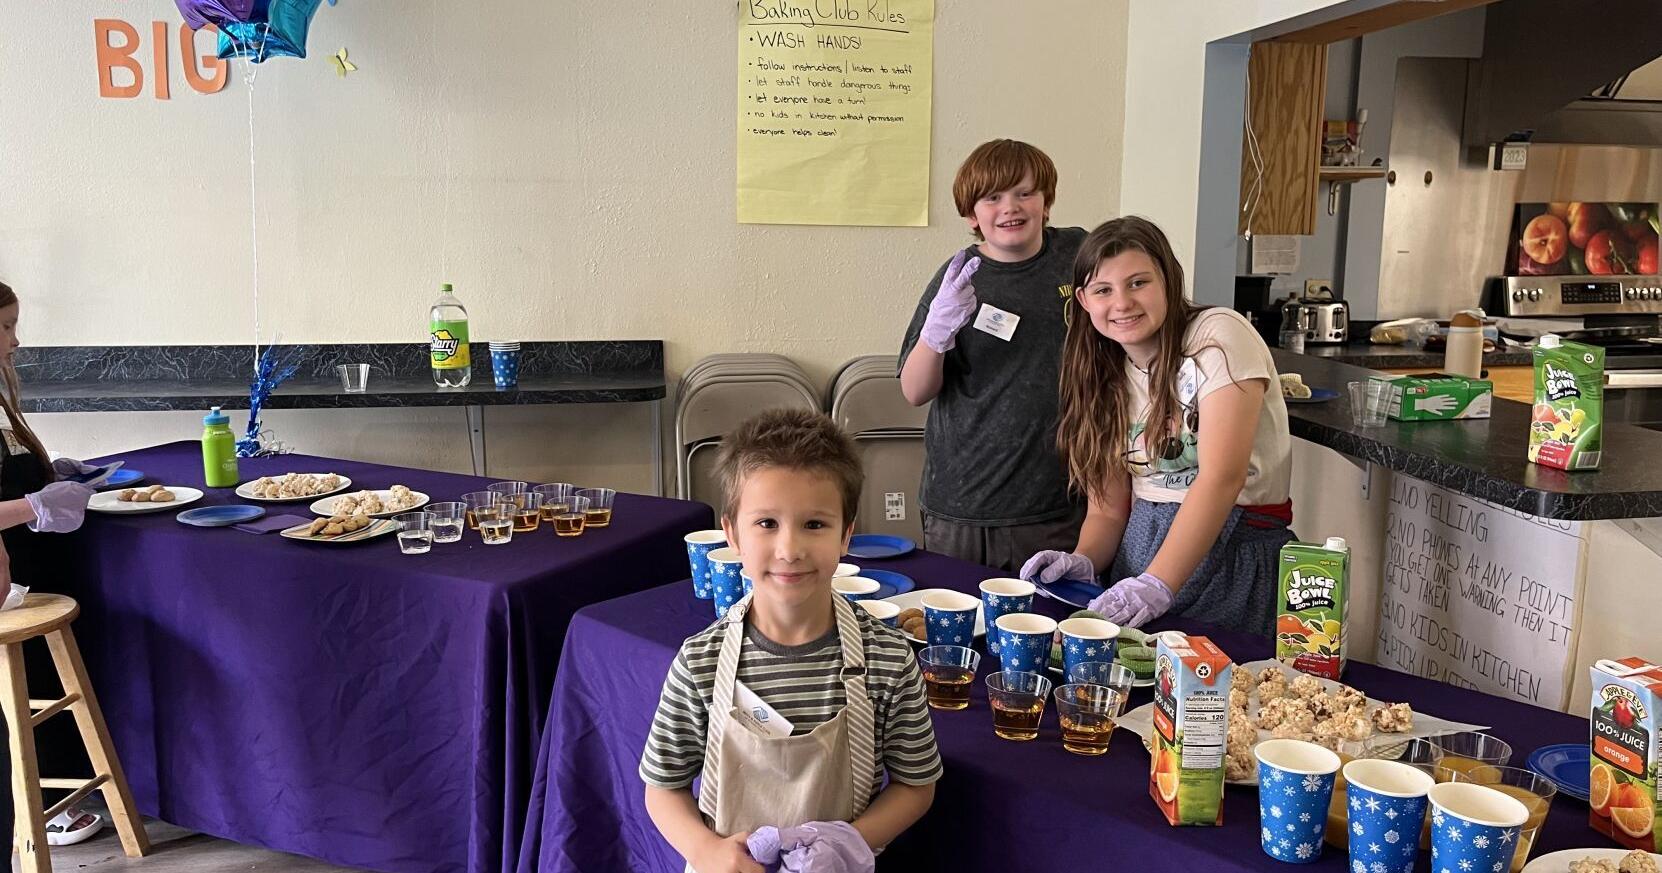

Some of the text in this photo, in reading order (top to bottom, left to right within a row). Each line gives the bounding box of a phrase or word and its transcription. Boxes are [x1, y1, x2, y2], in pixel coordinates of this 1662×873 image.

[749, 0, 905, 28] Baking Club Rules
[757, 31, 863, 50] WASH HANDS!
[94, 18, 229, 100] BIG
[757, 58, 786, 71] follow
[792, 61, 842, 73] instructions
[852, 63, 875, 73] listen
[880, 65, 889, 73] to
[892, 65, 912, 75] staff
[756, 76, 911, 94] let staff handle dangerous things
[756, 92, 767, 103] let
[773, 96, 808, 105] everyone
[813, 96, 831, 104] have
[771, 110, 789, 119] kids
[810, 112, 837, 120] kitchen
[840, 113, 864, 121] without
[868, 115, 905, 123] permission
[753, 128, 785, 137] everyone
[792, 128, 812, 137] helps
[1546, 363, 1576, 381] JUICE
[1163, 474, 1182, 488] The
[1425, 492, 1488, 542] YELLING
[1290, 569, 1336, 589] JUICE
[1422, 529, 1461, 571] PHONES
[1482, 562, 1512, 594] ANY
[1519, 576, 1573, 620] POINT
[1287, 587, 1332, 605] BOWL
[1386, 562, 1450, 612] GETS TAKEN
[1388, 542, 1573, 646] YOU GET ONE WARNING THEN IT
[1410, 611, 1448, 651] KIDS
[1450, 633, 1468, 661] IN
[1472, 643, 1542, 702] KITCHEN
[1420, 656, 1438, 679] UP
[1604, 686, 1625, 700] APPLE
[1632, 695, 1646, 715] EVE
[1595, 720, 1645, 751] 100% JUICE
[1604, 744, 1630, 763] orange
